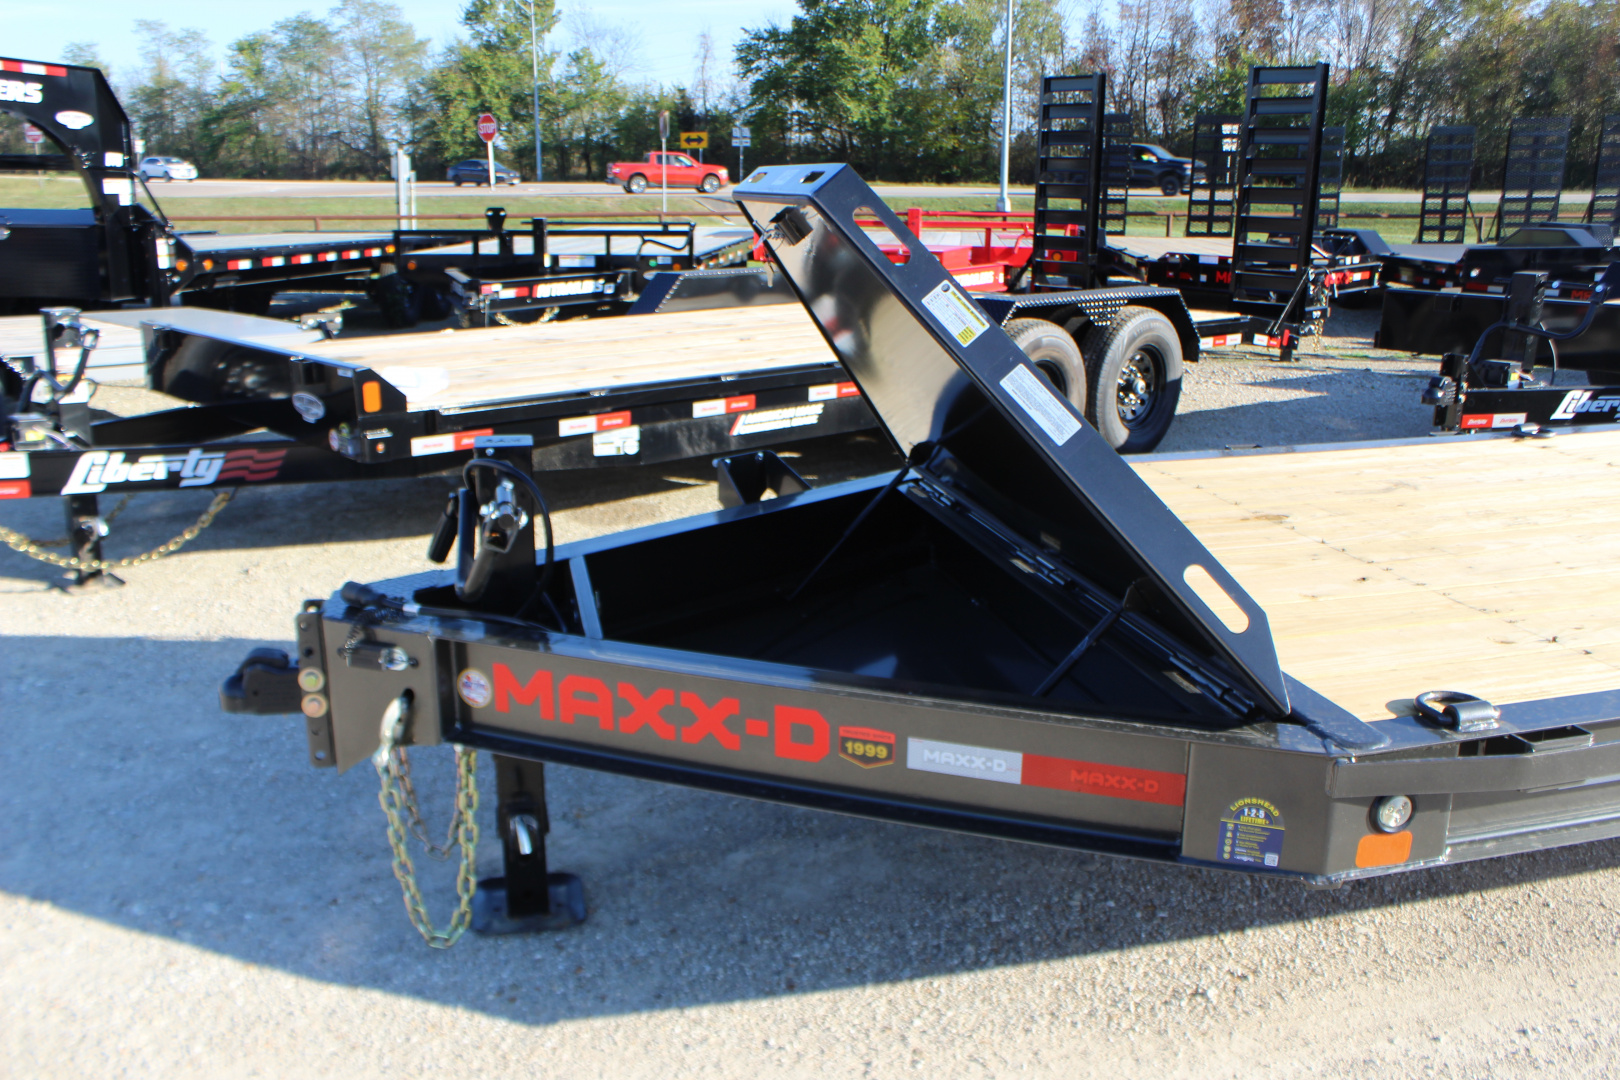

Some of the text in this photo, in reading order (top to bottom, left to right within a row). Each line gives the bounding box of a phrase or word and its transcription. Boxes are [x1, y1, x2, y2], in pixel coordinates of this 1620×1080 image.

[479, 123, 496, 134] STOP
[60, 448, 227, 497] Liberty
[492, 662, 831, 764] MAXX-D
[844, 739, 889, 760] 1999
[922, 748, 1008, 774] MAXX-D
[1069, 769, 1160, 795] MAXX-D
[1229, 797, 1280, 817] LIONSHEAD
